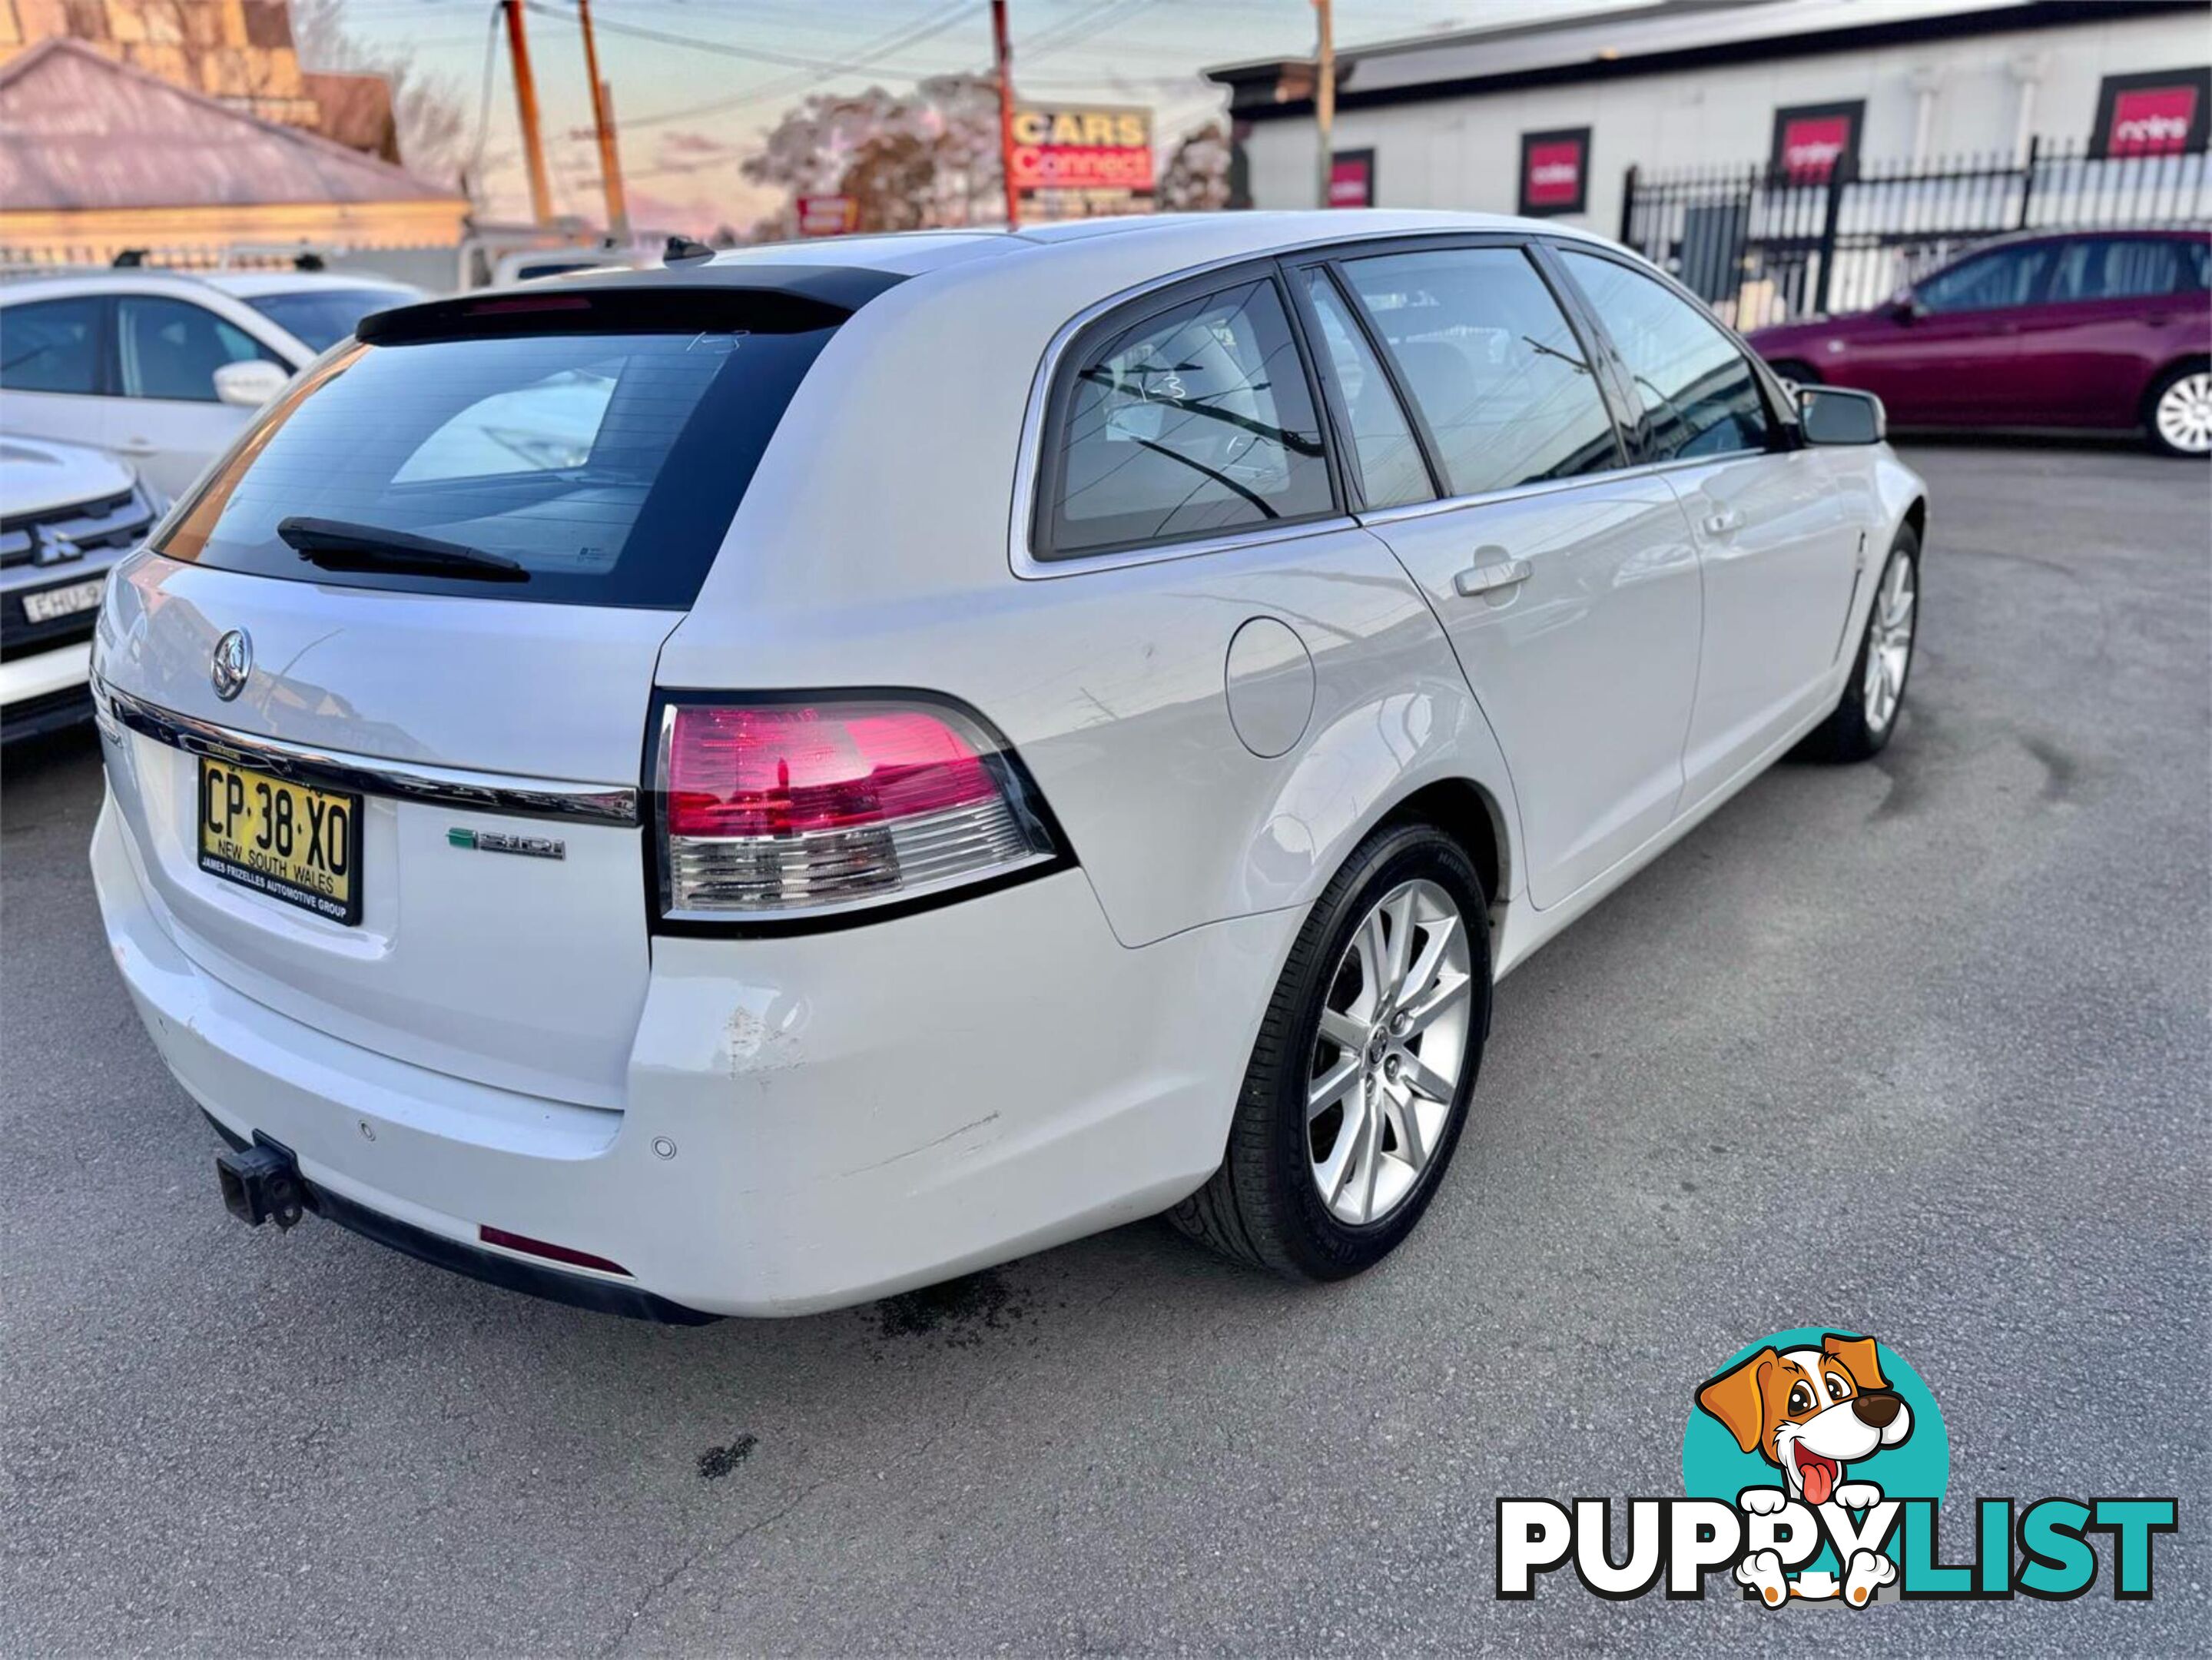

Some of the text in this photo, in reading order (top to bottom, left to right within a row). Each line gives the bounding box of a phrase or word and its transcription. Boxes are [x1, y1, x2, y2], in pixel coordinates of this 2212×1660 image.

[1012, 111, 1144, 146] CARS
[1011, 147, 1150, 178] Connect
[202, 857, 347, 918] JAMES FRIZELLES AUTOMOTIVE GROUP
[217, 840, 333, 894] NEW SOUTH WALES
